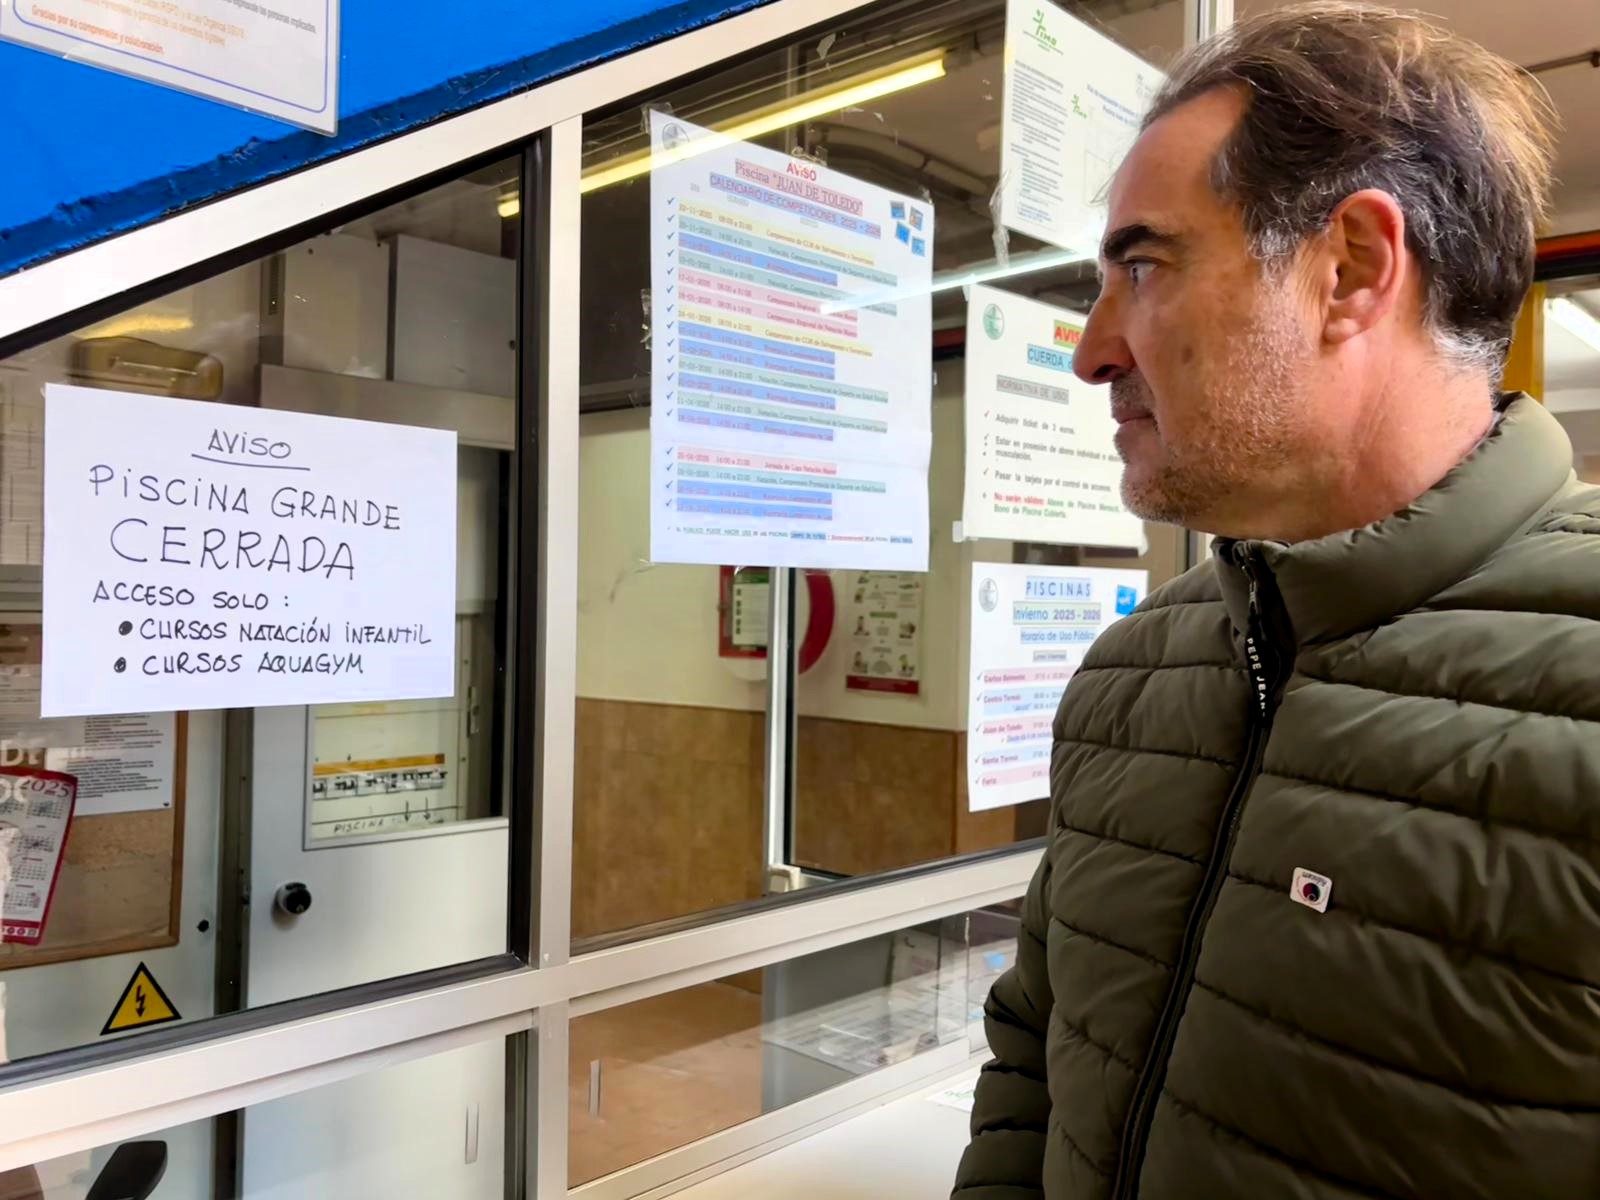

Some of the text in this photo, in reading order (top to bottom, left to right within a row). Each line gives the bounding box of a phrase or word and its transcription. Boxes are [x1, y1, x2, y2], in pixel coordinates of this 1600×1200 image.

[735, 161, 770, 184] Piscina
[804, 184, 819, 197] DE
[1028, 348, 1064, 367] CUERDA
[995, 469, 1011, 480] Pasar
[270, 487, 401, 531] GRANDE
[110, 518, 356, 580] CERRADA
[93, 580, 195, 607] ACCESO
[212, 592, 269, 610] SOLO
[1025, 581, 1091, 597] PISCINAS
[1014, 606, 1048, 621] Invierno
[1053, 608, 1075, 620] 2025
[139, 618, 228, 640] CURSOS
[1021, 631, 1045, 641] Horario
[1047, 631, 1057, 640] de
[142, 652, 364, 676] CURSOS AQUAGYM
[1246, 637, 1260, 670] PEPE
